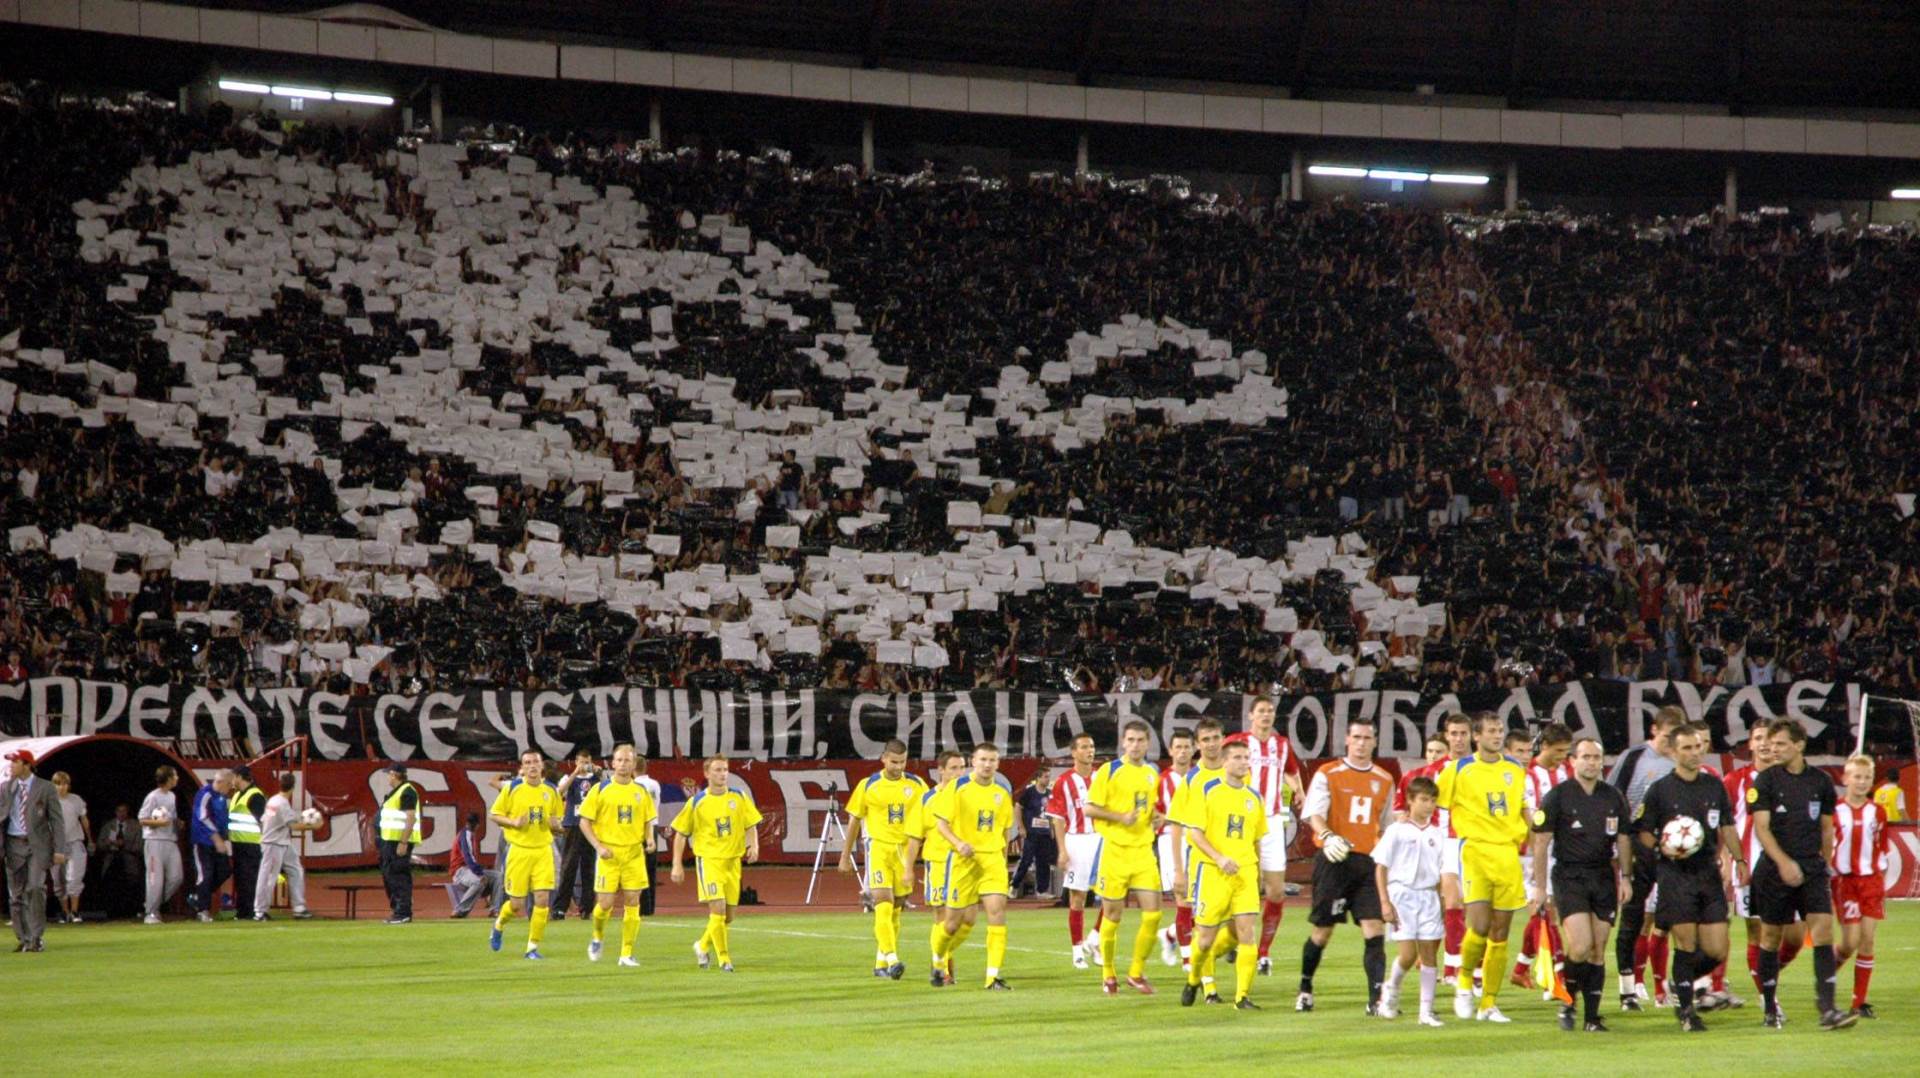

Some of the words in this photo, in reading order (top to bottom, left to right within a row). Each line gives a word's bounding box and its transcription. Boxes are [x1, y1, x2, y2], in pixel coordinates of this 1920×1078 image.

[374, 691, 465, 761] СЕ
[482, 687, 829, 762] ЧЕТНИЦИ,
[707, 882, 718, 895] 10
[952, 889, 959, 903] 4
